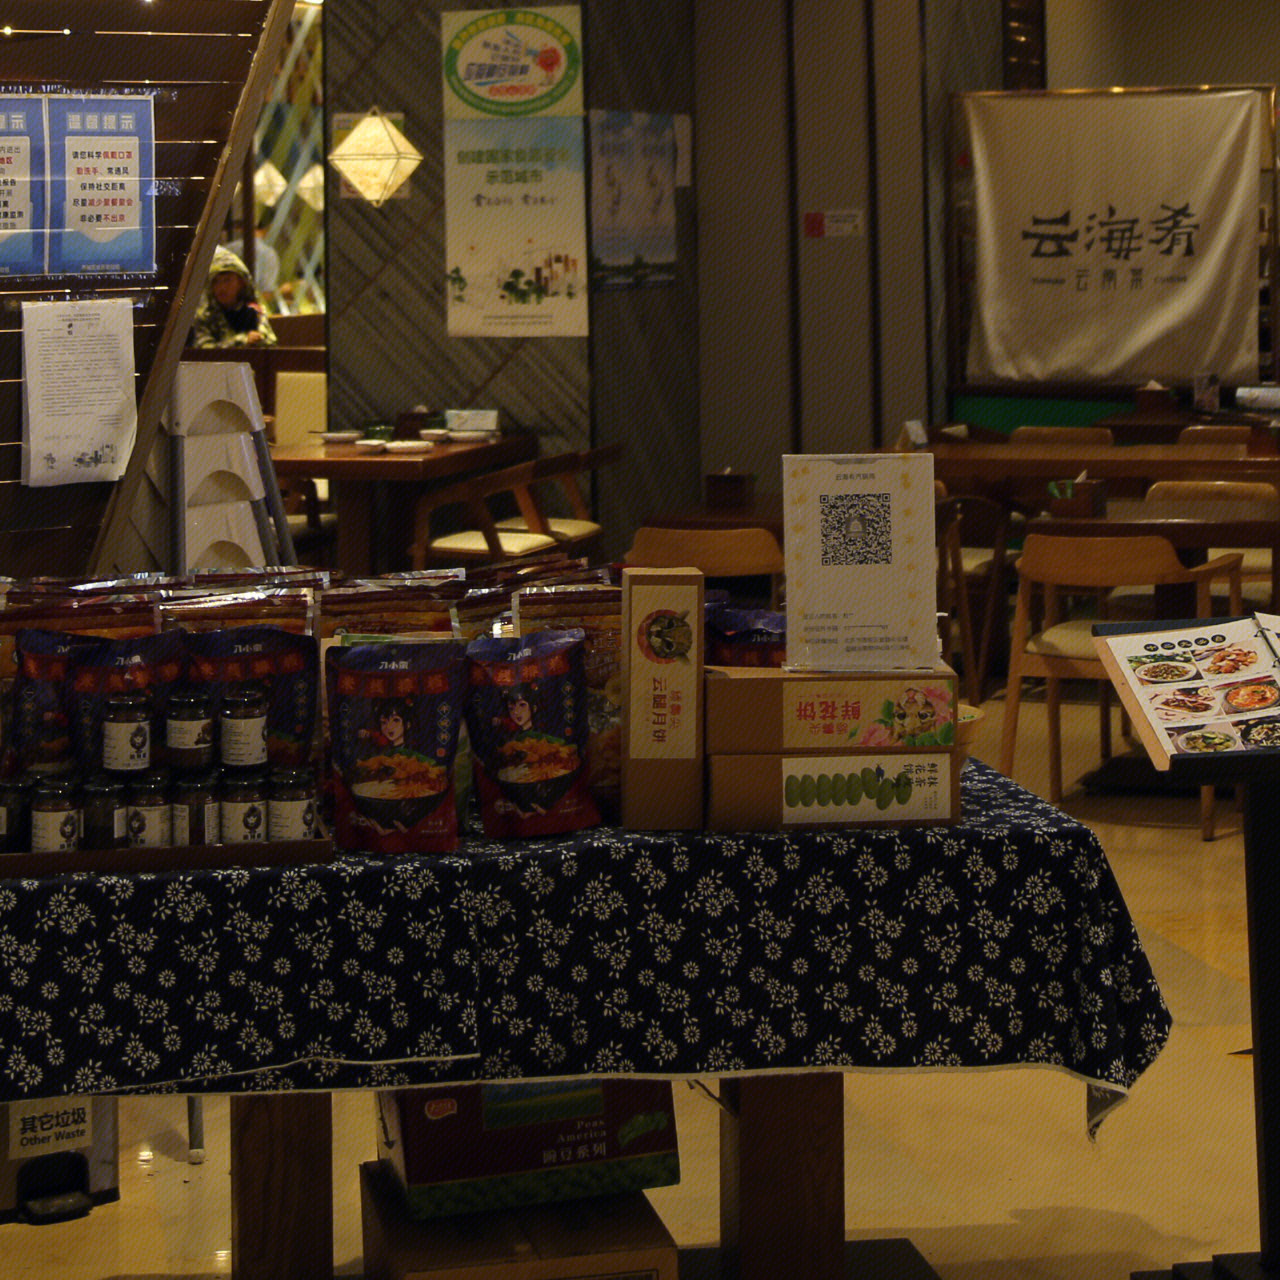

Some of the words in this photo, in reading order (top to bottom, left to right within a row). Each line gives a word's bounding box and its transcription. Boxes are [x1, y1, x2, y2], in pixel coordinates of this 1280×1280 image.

[80, 183, 126, 191] 保持社交距离
[1022, 203, 1200, 260] 云海肴
[796, 701, 861, 721] 鲜花饼
[20, 1107, 87, 1135] 其它垃圾
[21, 1134, 52, 1147] Other
[54, 1128, 86, 1141] Waste
[557, 1129, 607, 1144] America
[543, 1142, 607, 1164] 豌豆系列
